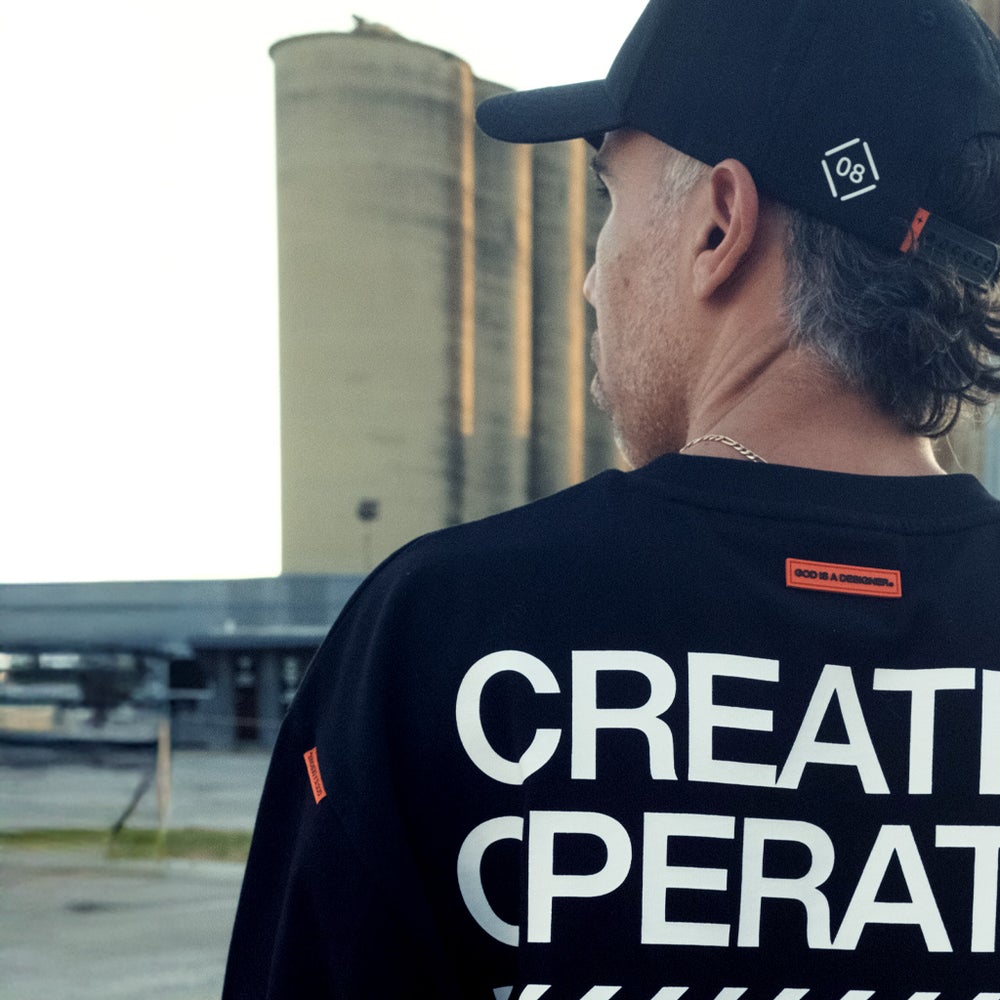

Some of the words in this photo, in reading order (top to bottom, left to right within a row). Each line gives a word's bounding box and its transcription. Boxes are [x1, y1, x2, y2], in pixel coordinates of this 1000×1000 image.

[836, 157, 865, 183] 08
[794, 568, 818, 579] GOD
[818, 571, 829, 581] IS
[830, 573, 838, 582] A
